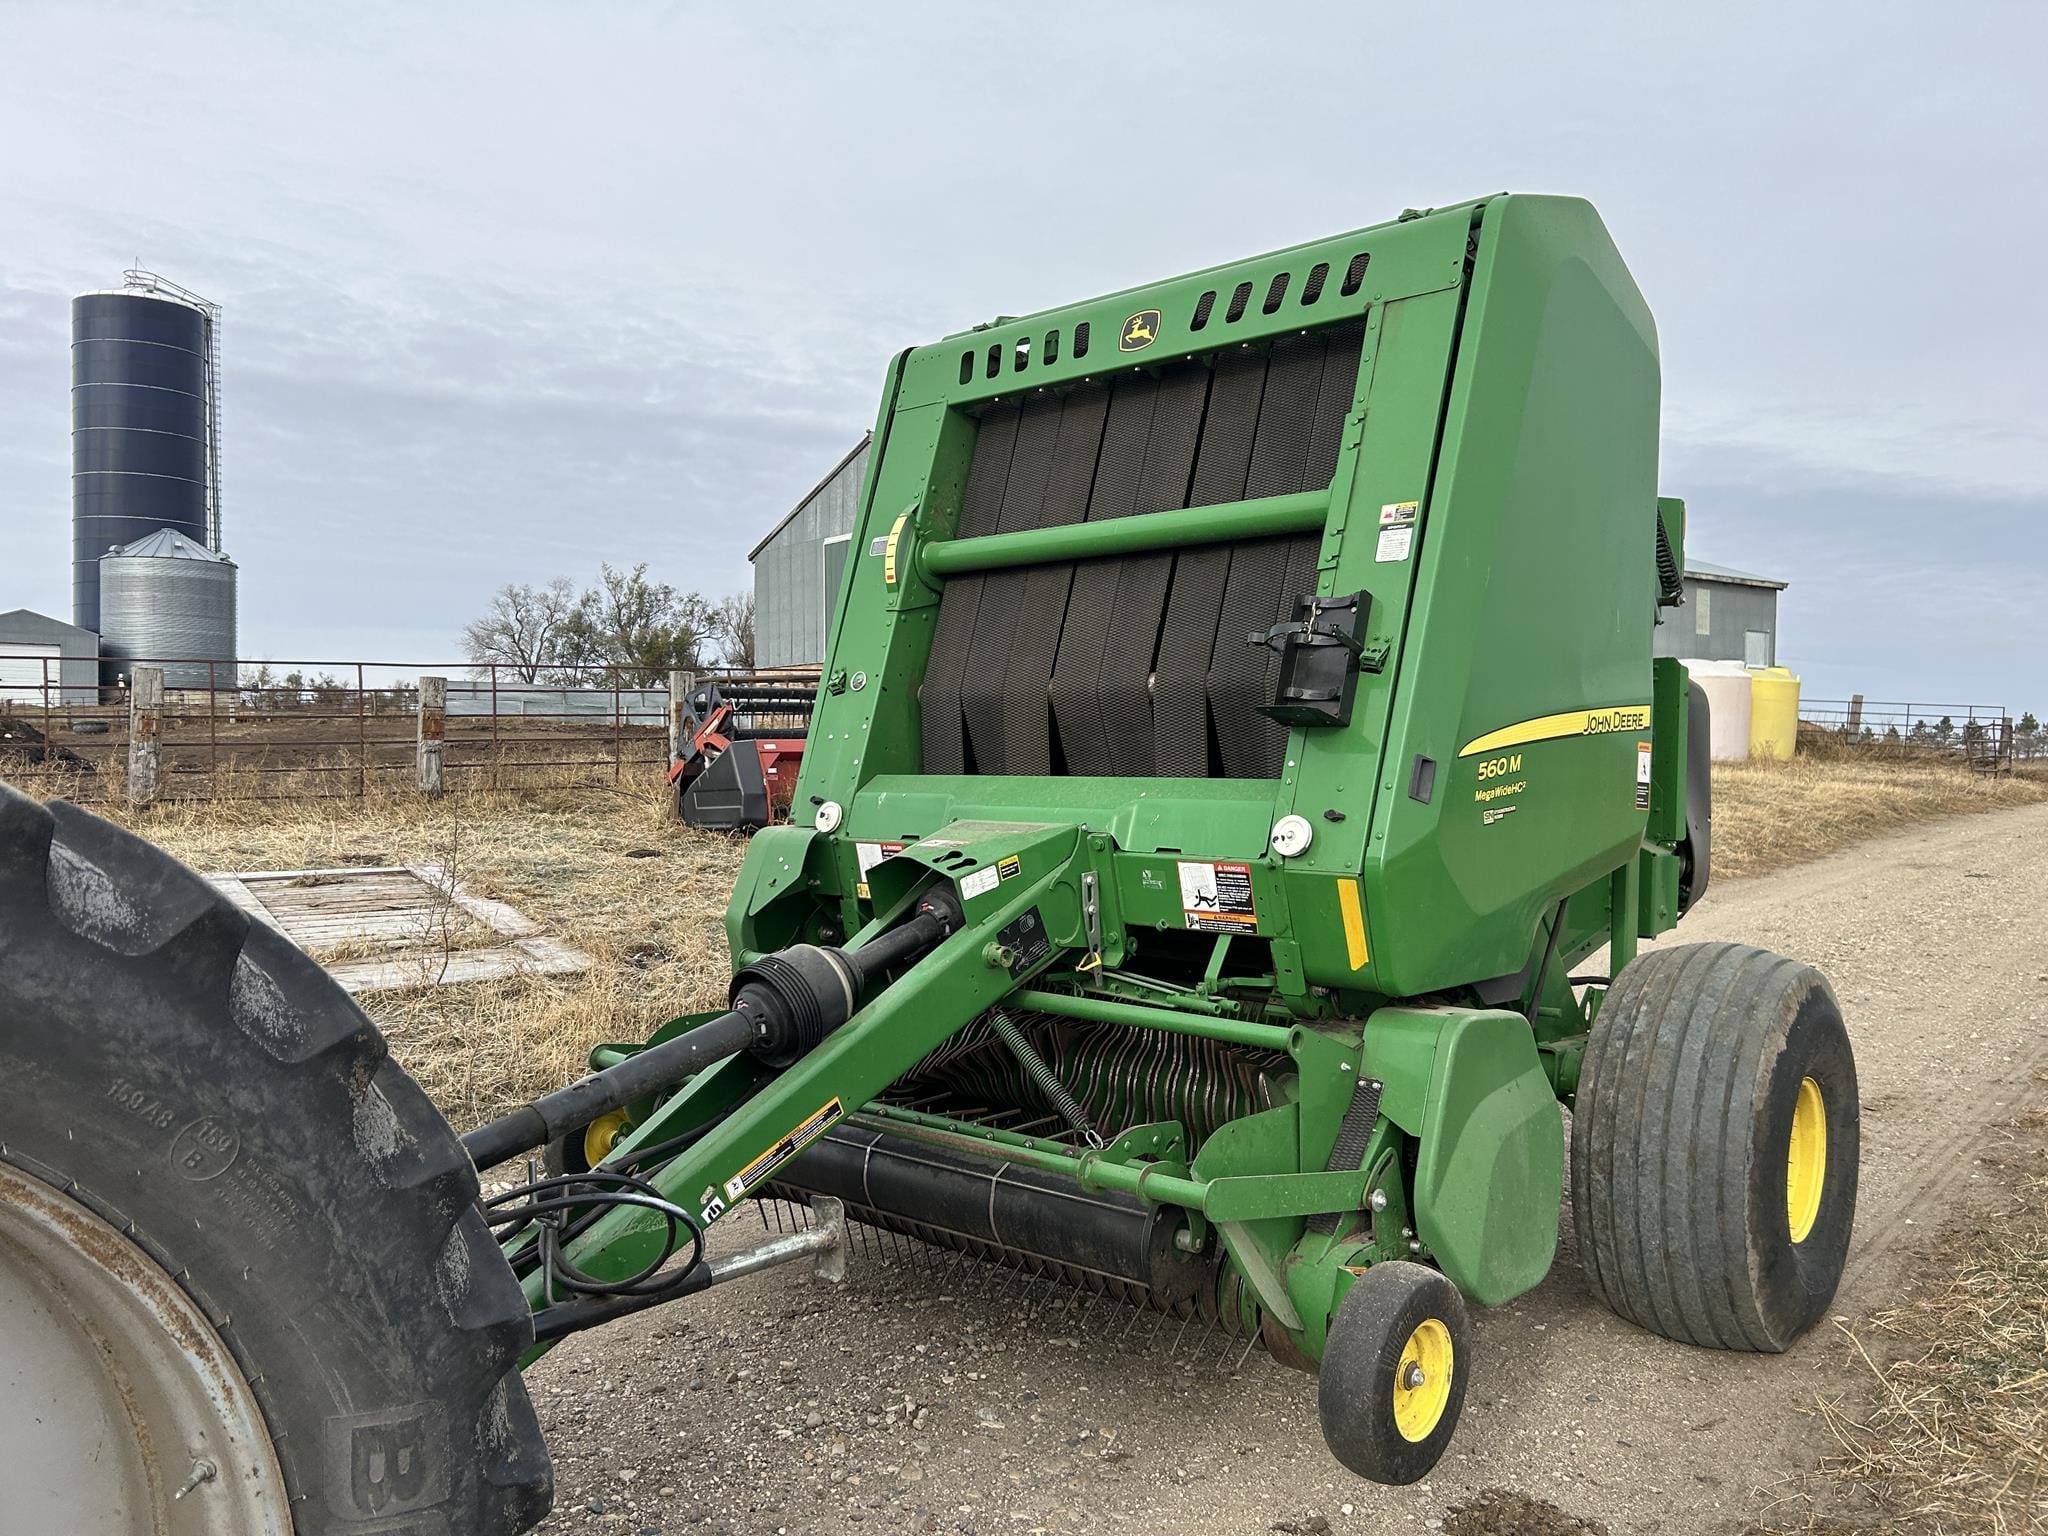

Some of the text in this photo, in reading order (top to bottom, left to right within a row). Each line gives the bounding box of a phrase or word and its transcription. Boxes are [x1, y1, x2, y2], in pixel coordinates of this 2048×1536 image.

[1583, 711, 1643, 732] JOHN DEERE
[1478, 754, 1522, 781] 560 M
[1223, 865, 1246, 873] DANGER
